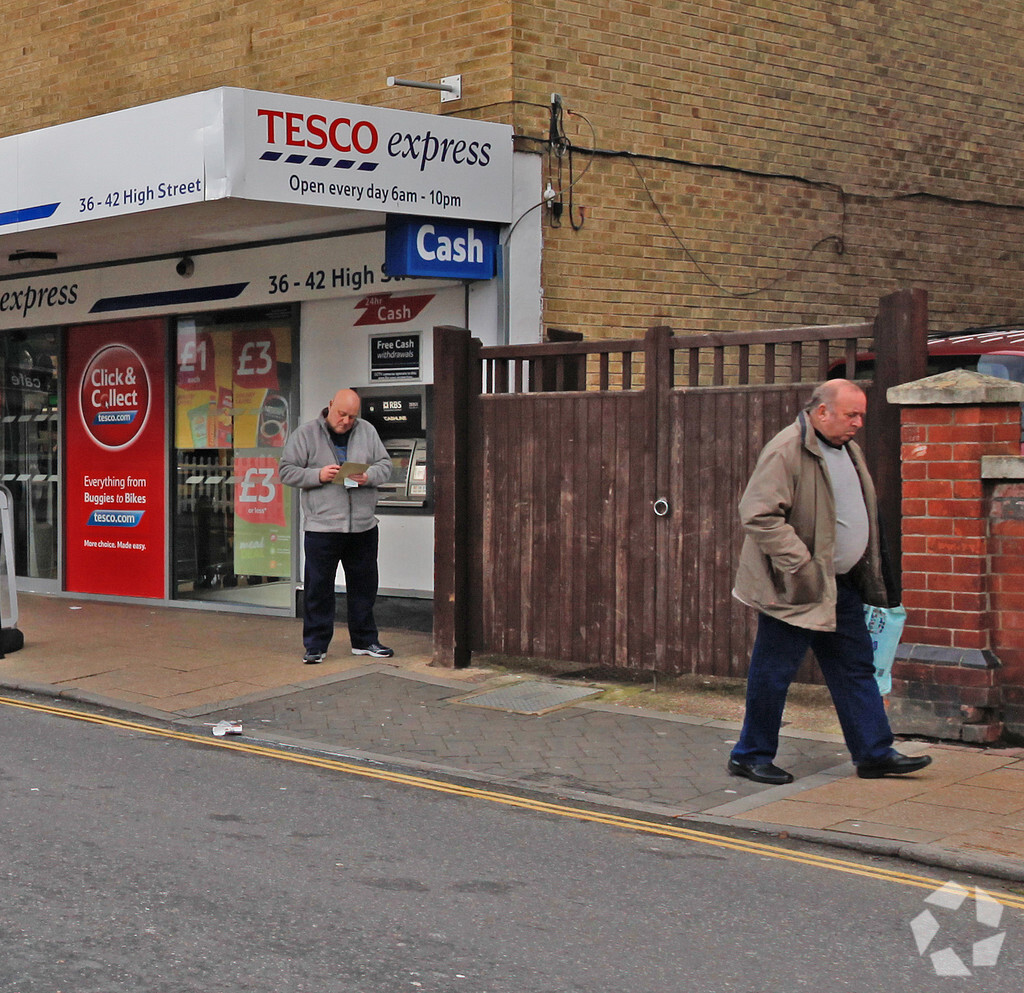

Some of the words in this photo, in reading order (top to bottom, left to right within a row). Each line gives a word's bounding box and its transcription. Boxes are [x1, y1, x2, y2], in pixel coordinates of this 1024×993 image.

[257, 109, 379, 155] TESCO
[387, 131, 492, 171] express
[79, 196, 95, 213] 36
[105, 192, 120, 207] 42
[123, 186, 154, 206] High
[157, 178, 202, 198] Street
[289, 175, 325, 195] Open
[329, 181, 364, 201] every
[366, 183, 389, 204] day
[391, 186, 417, 203] 6am
[429, 190, 461, 209] 10pm
[416, 224, 484, 263] Cash
[268, 274, 289, 294] 36
[305, 270, 326, 290] 42
[331, 265, 375, 290] High
[0, 283, 79, 318] express
[364, 297, 383, 306] 24hr
[377, 305, 412, 321] Cash
[377, 340, 394, 350] Free
[395, 339, 414, 349] Cash
[179, 340, 207, 372] £1
[237, 340, 273, 376] £3
[377, 350, 414, 359] withdrawals
[91, 368, 124, 387] Click
[125, 366, 136, 385] &
[389, 400, 402, 409] RBS
[98, 414, 131, 422] tesco.com
[84, 475, 125, 490] Everything
[127, 475, 147, 487] from
[239, 467, 276, 503] £3
[84, 492, 115, 505] Buggies
[116, 494, 124, 503] to
[124, 493, 147, 504] Bikes
[93, 512, 135, 523] tesco.com
[84, 539, 97, 547] More
[97, 540, 116, 549] choice.
[116, 541, 132, 550] Made
[132, 543, 147, 551] easy.
